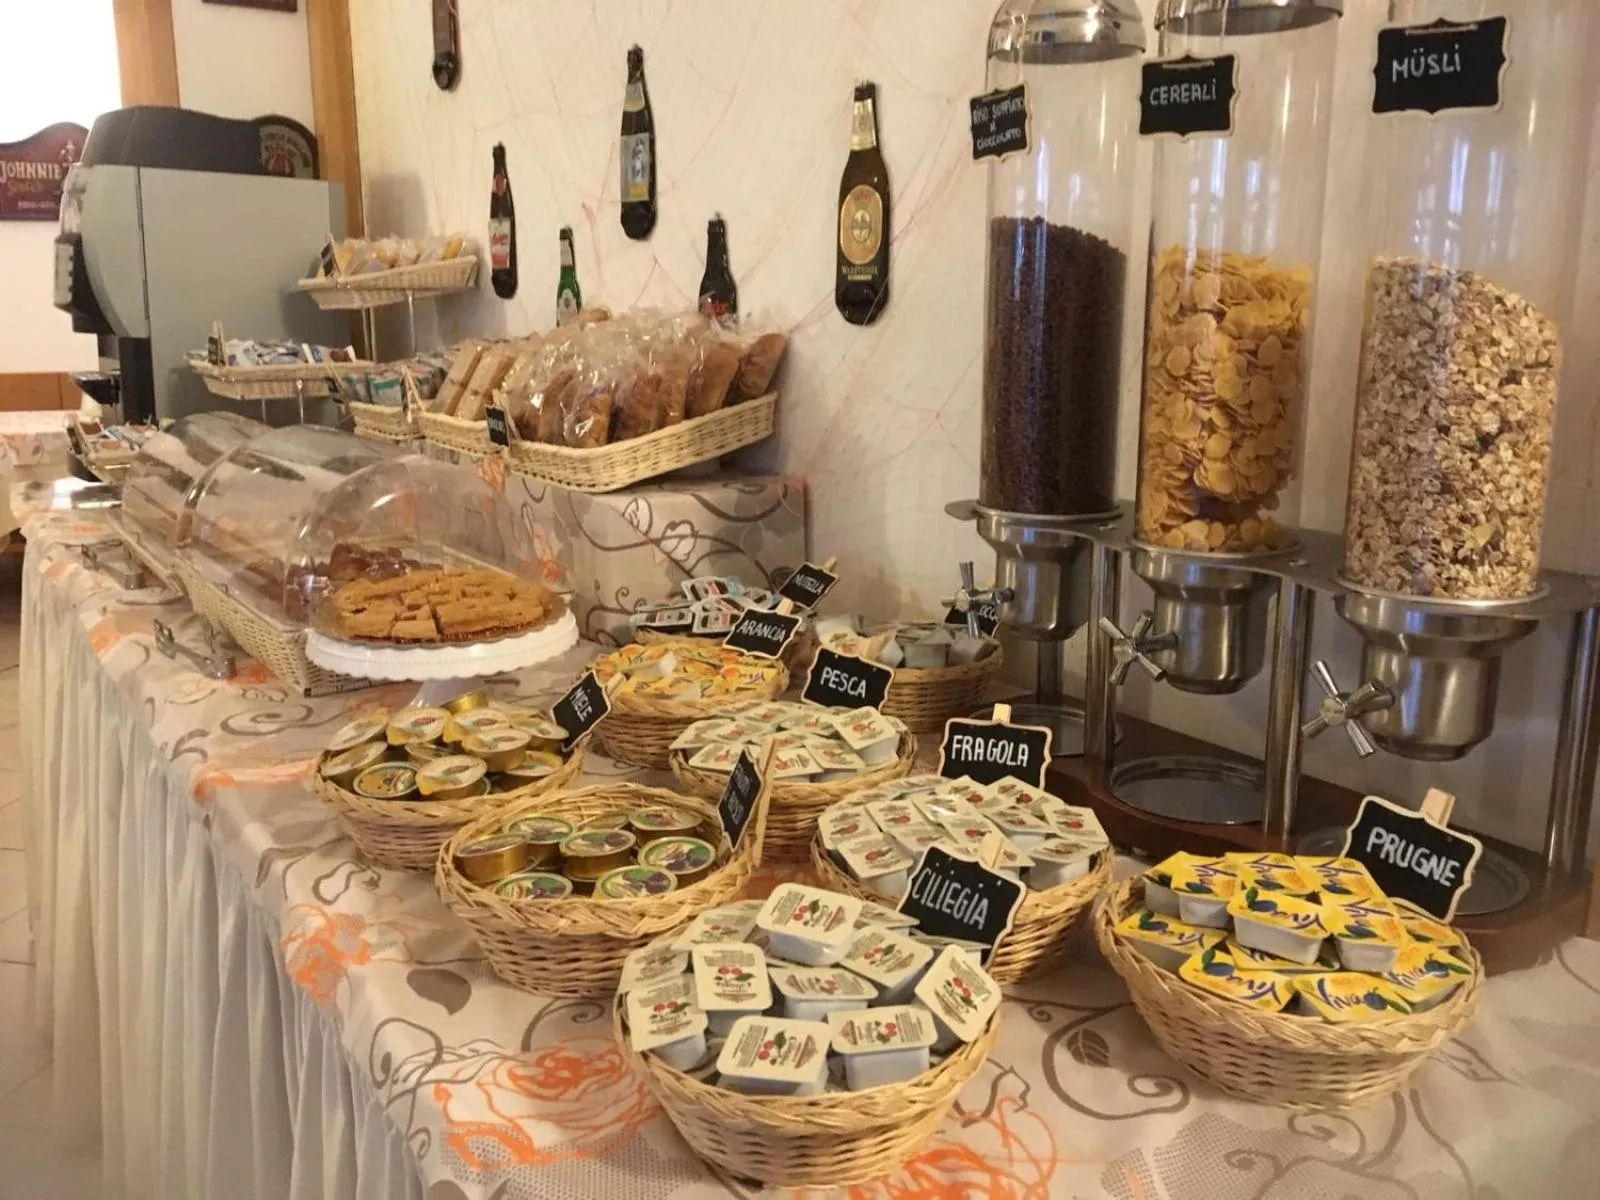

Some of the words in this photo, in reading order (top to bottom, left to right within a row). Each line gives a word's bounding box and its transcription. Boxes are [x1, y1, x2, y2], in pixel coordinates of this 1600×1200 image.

[1392, 43, 1461, 82] MÜSLI
[1150, 77, 1216, 106] CEREALI
[0, 161, 62, 183] JOHNNIE
[792, 573, 825, 596] NUTELLA
[736, 619, 787, 643] ARANCIA
[820, 666, 867, 699] PESCA
[569, 686, 593, 722] MIELE
[951, 734, 1029, 768] FRAGOLA
[1366, 826, 1460, 887] PRUGNE
[912, 862, 989, 930] CILIEGIA
